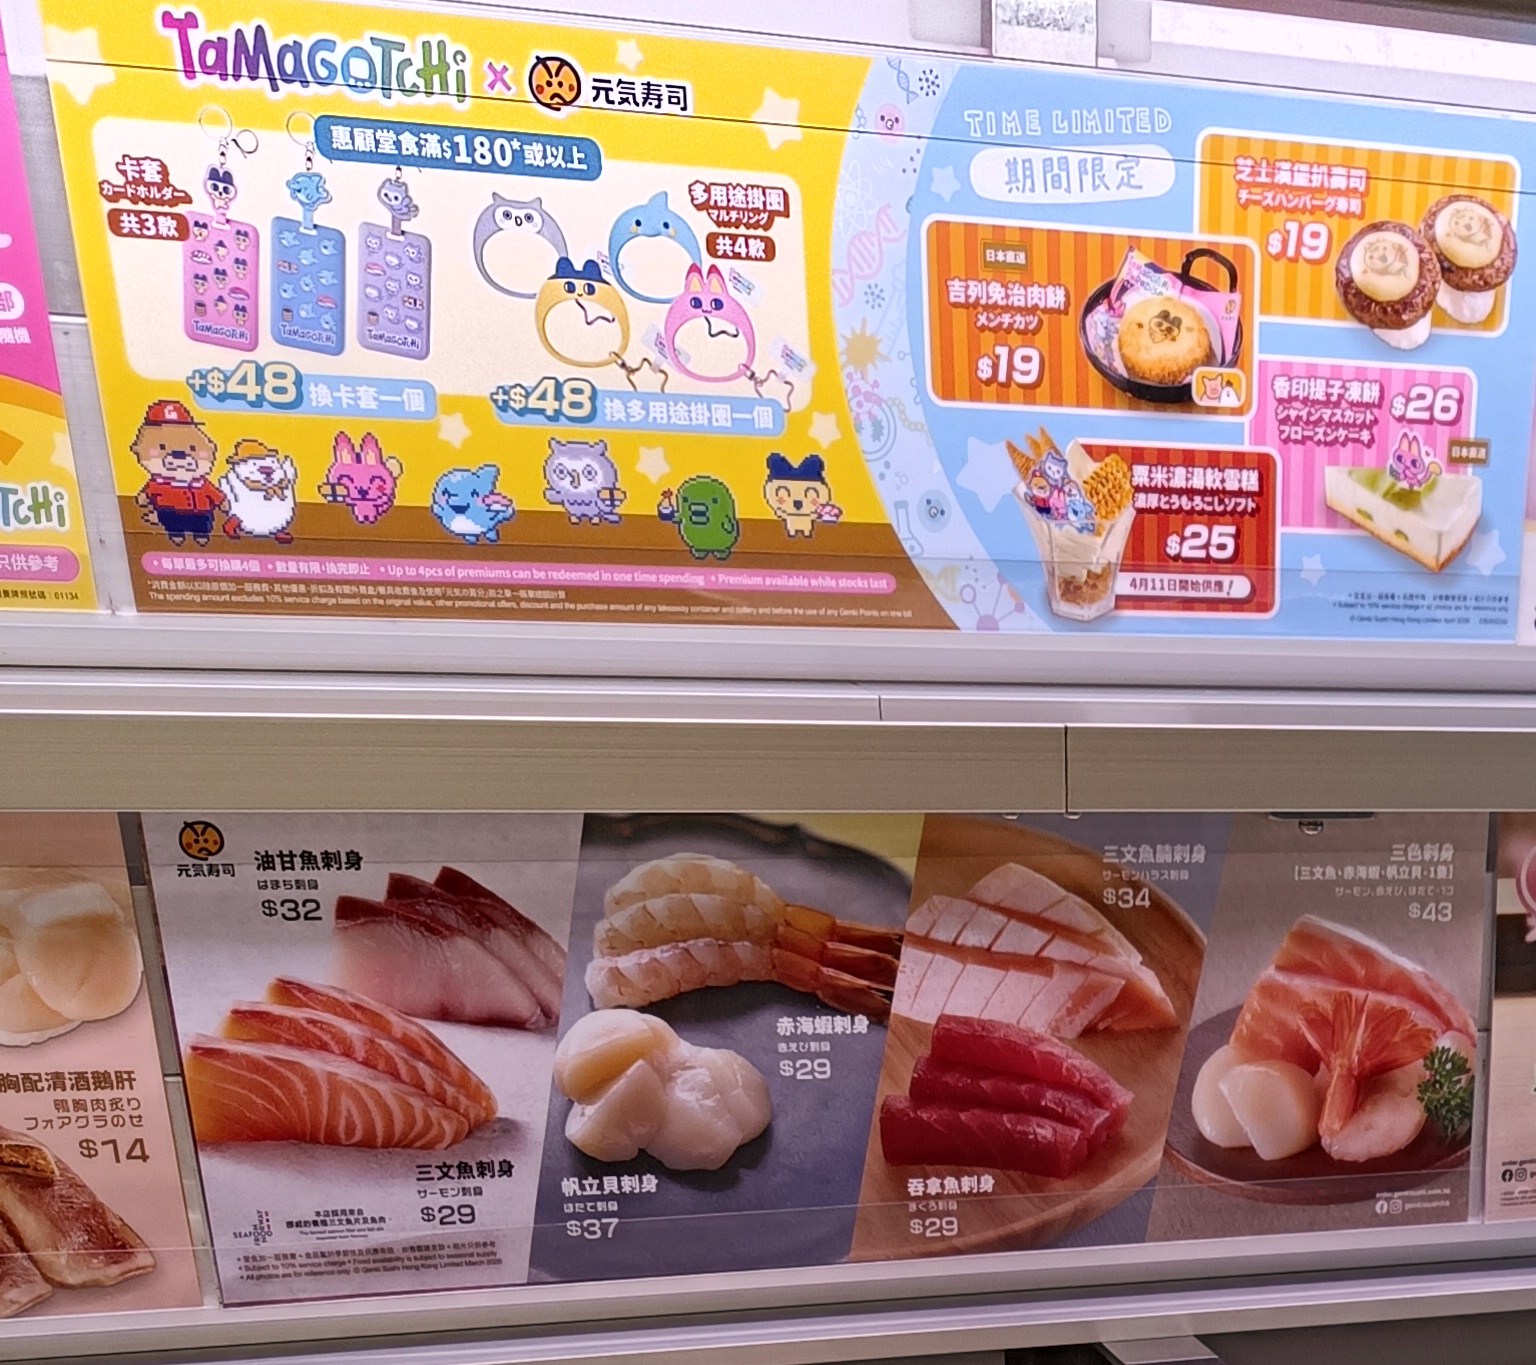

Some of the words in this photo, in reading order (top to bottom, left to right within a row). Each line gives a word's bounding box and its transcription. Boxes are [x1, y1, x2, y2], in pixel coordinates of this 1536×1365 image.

[590, 75, 690, 113] 元気寿司
[964, 109, 1041, 136] TIME
[1053, 107, 1172, 134] LIMITED
[118, 158, 162, 183] 卡套
[1005, 153, 1144, 194] 期間限定
[102, 183, 187, 200] カードホルダー
[689, 184, 785, 211] 多用途掛圈
[120, 214, 180, 238] 共3款
[709, 210, 769, 225] マルチリング
[715, 237, 767, 259] 共4款
[1268, 220, 1328, 260] $19
[986, 249, 1027, 265] 日本直送
[946, 279, 1067, 310] 吉列免治肉餅
[975, 312, 1039, 330] メンチカツ
[977, 344, 1041, 385] $19
[309, 382, 426, 413] 換卡套一個
[1391, 386, 1459, 422] $26
[605, 399, 773, 429] 換多用途掛圈一個
[1276, 405, 1375, 425] シャインマスカット
[1279, 425, 1372, 444] フローズンケーキ
[1165, 523, 1237, 560] $25
[388, 565, 402, 578] Up
[404, 566, 415, 576] to
[418, 565, 442, 579] 4pcs
[445, 565, 456, 577] of
[457, 566, 509, 579] premiums
[512, 570, 529, 580] can
[531, 569, 545, 580] be
[547, 570, 599, 582] redeemed
[602, 570, 611, 582] in
[613, 573, 632, 582] one
[634, 571, 657, 583] time
[659, 572, 705, 586] spending
[718, 574, 763, 585] Premium
[765, 575, 808, 587] available
[810, 576, 835, 588] while
[838, 577, 868, 588] stocks
[870, 578, 888, 589] last
[254, 850, 364, 872] 油甘魚刺身
[1390, 843, 1454, 862] 三色刺身
[177, 864, 236, 878] 元気寿司
[257, 878, 319, 891] はまち刺身
[1103, 887, 1151, 908] $34
[261, 898, 323, 922] $32
[1409, 901, 1453, 922] $43
[776, 1015, 869, 1036] 赤海蝦刺身
[779, 1058, 832, 1080] $29
[23, 1114, 144, 1131] フォアグラのせ
[79, 1137, 150, 1165] $14
[416, 1159, 515, 1181] 三文魚刺身
[561, 1174, 659, 1196] 帆立貝刺身
[421, 1203, 477, 1226] $29
[566, 1218, 620, 1240] $37
[910, 1216, 959, 1238] $29
